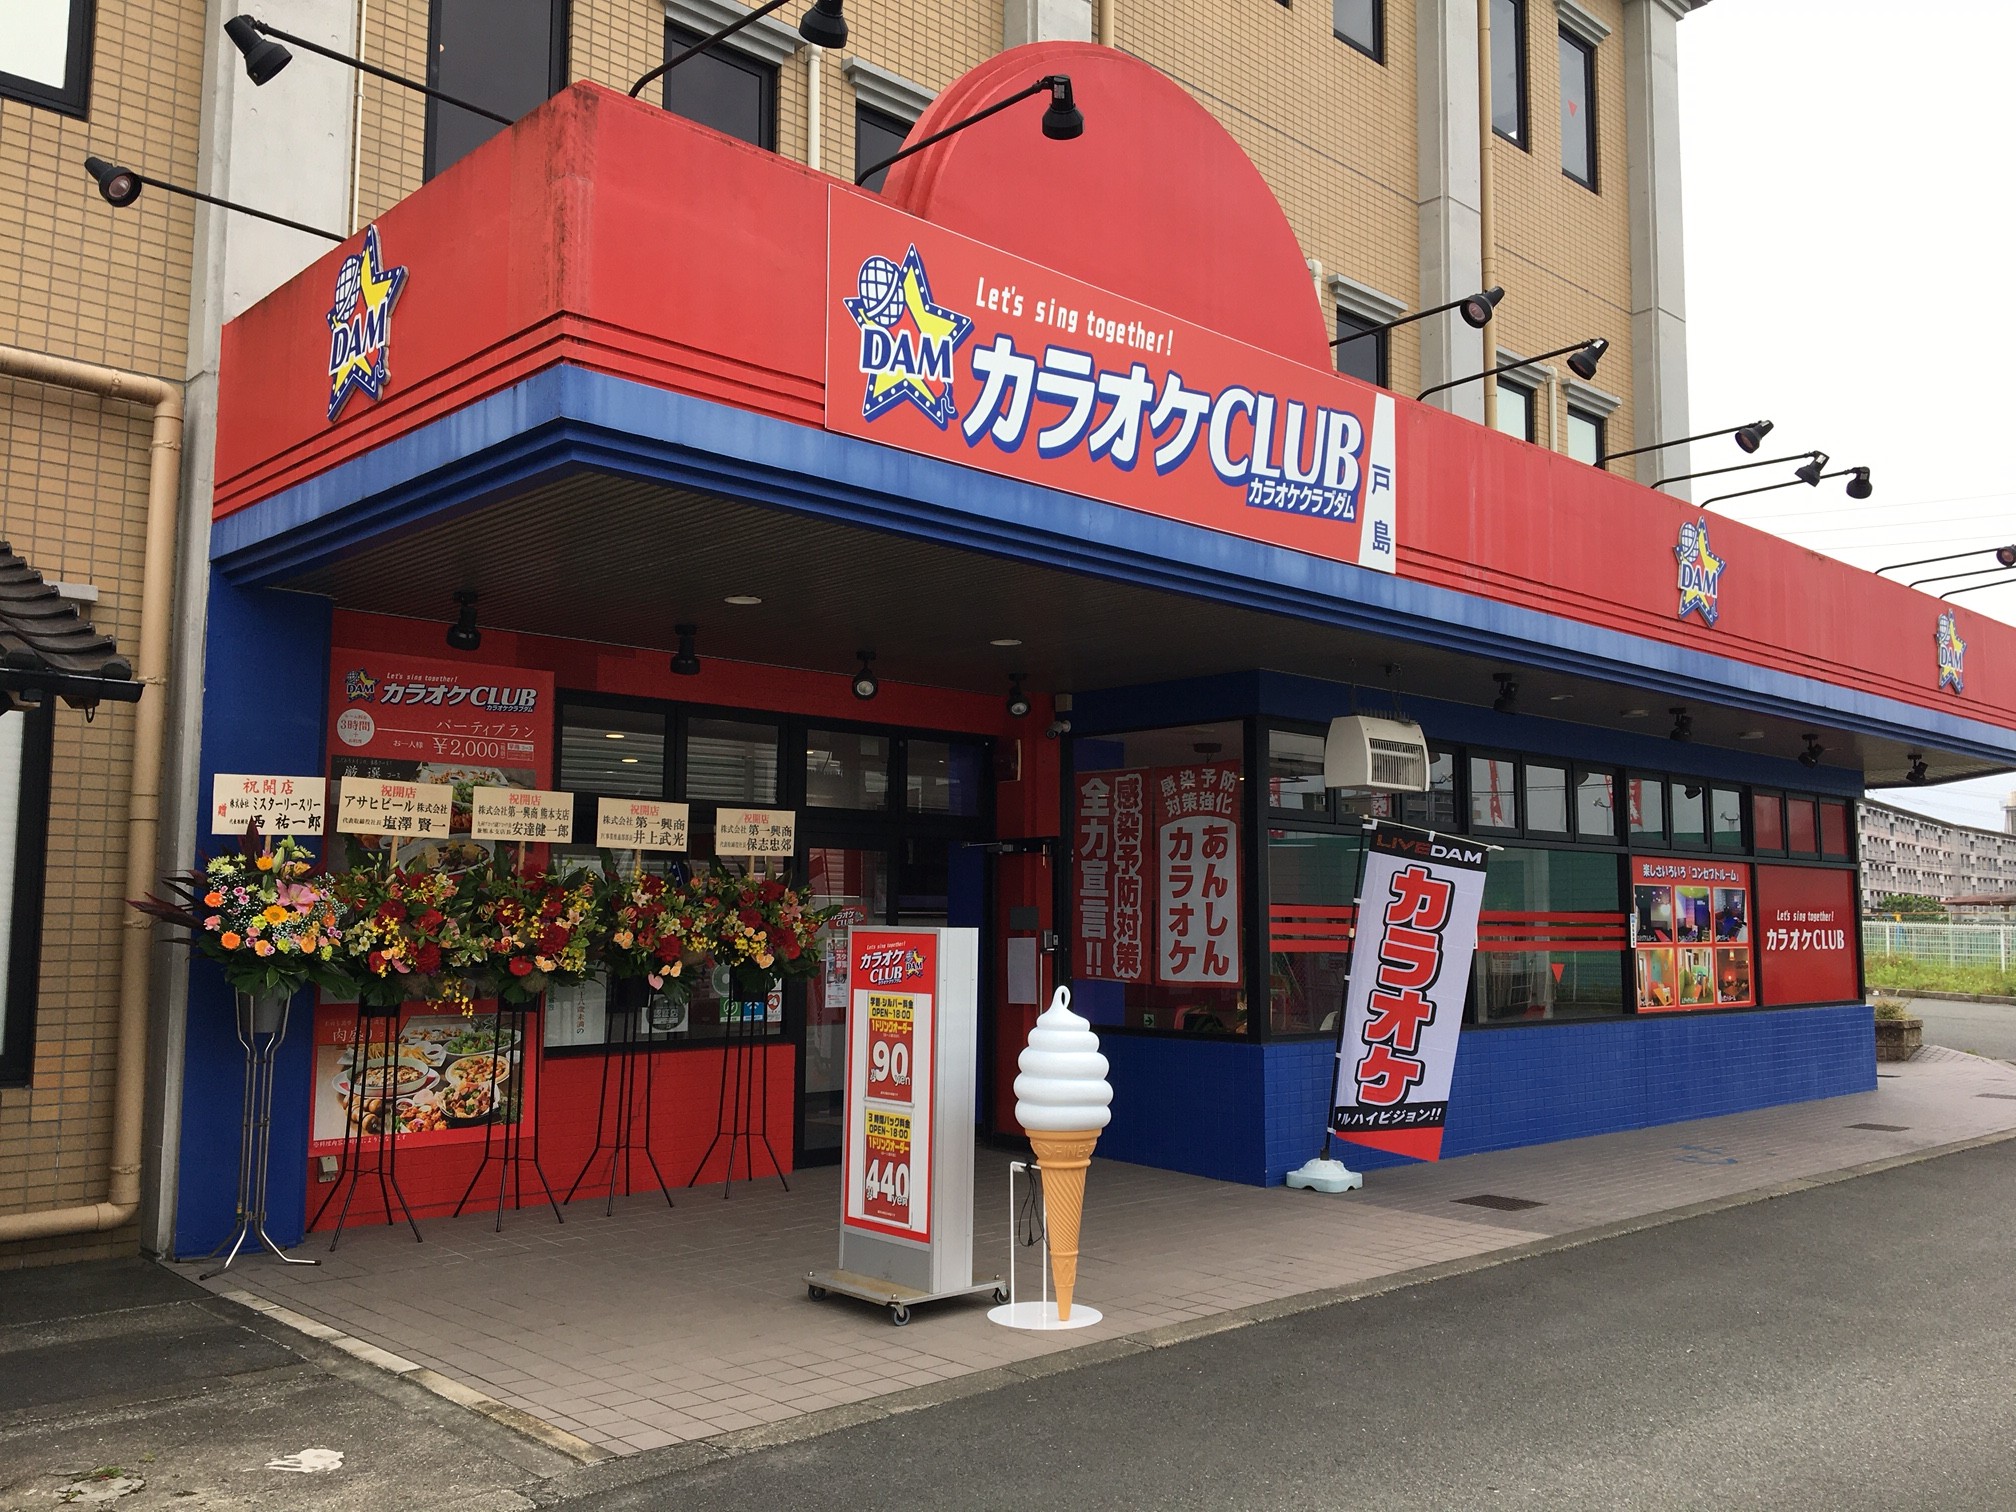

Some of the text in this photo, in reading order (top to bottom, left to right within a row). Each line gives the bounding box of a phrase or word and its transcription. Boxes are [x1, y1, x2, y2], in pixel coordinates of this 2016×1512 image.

[975, 276, 1175, 356] Let's sing together!
[329, 297, 387, 376] DAM
[861, 326, 953, 382] DAM
[963, 337, 1362, 492] カラオケCLUB
[1248, 477, 1354, 520] カラオケクラブダム
[1371, 462, 1392, 555] 戸島
[1681, 564, 1717, 597] DAM
[1939, 646, 1963, 672] DAM
[347, 682, 374, 695] DAM
[381, 683, 536, 707] カラオケCLUB
[340, 719, 371, 732] 3時間
[436, 720, 534, 739] パーティプラン
[393, 739, 424, 750] お一人様
[433, 737, 499, 760] ¥2,000
[243, 778, 295, 796] 祝開店
[380, 784, 417, 799] 祝開店
[1160, 768, 1237, 797] 感染予防
[229, 797, 321, 811] 株式会社 ミスターリースリー
[344, 795, 448, 815] アサヒビール 株式会社
[509, 793, 541, 806] 祝開店
[630, 803, 660, 816] 祝開店
[1166, 791, 1232, 818] 対策強化
[275, 813, 322, 832] 祐一郎
[382, 815, 412, 831] 塩澤
[418, 817, 446, 832] 賢一
[540, 807, 570, 821] 熊本支店
[602, 815, 685, 831] 株式会社 第一興商
[744, 813, 770, 824] 祝開店
[512, 821, 569, 838] 安達健一郎
[633, 830, 684, 846] 井上武光
[720, 824, 792, 837] 株式会社 第一興商
[1115, 775, 1141, 977] 感染予防対策
[1168, 826, 1196, 975] カラオケ
[1201, 824, 1229, 976] あんしん
[1776, 909, 1834, 923] Let's sing together!
[1766, 928, 1845, 950] カラオケCLUB
[860, 950, 904, 970] カラオケ
[905, 961, 923, 971] DAM
[870, 966, 902, 983] CLUB
[1359, 866, 1453, 1106] カラオケ
[872, 1040, 909, 1082] 90
[894, 1074, 911, 1087] yen
[866, 1158, 910, 1202] 440
[891, 1194, 908, 1207] yen
